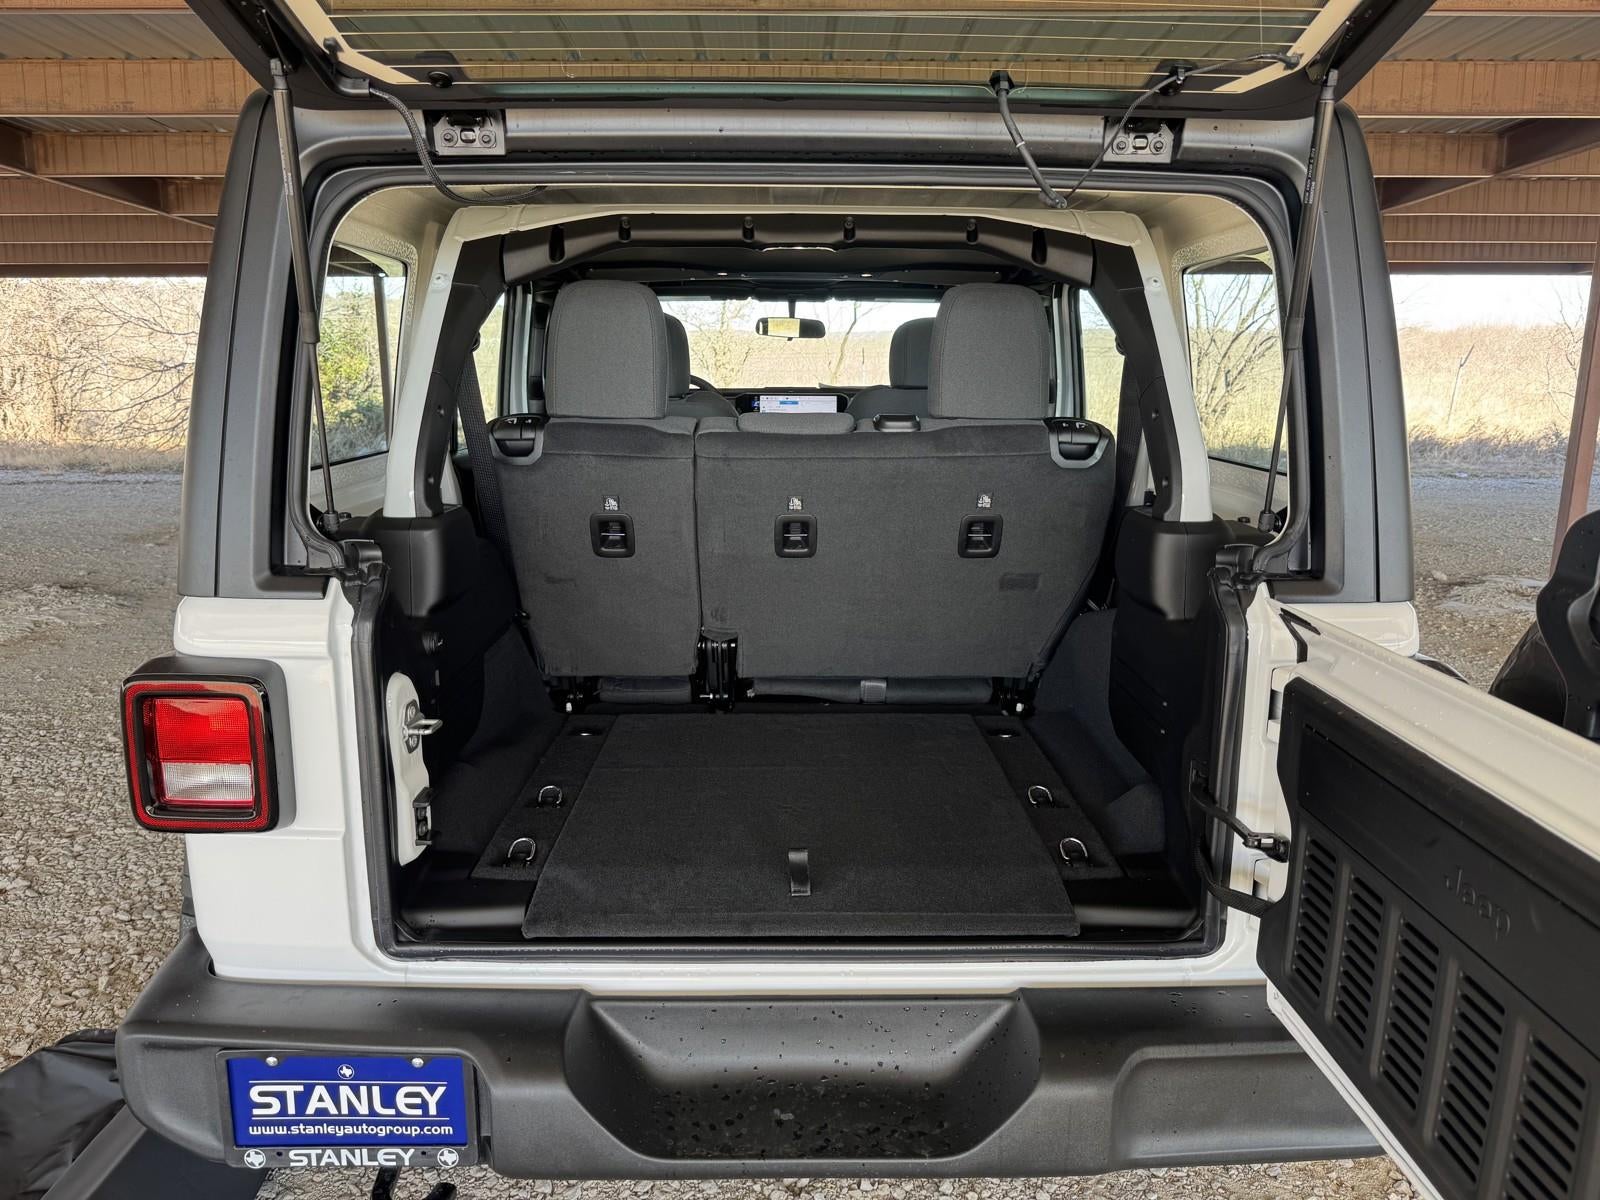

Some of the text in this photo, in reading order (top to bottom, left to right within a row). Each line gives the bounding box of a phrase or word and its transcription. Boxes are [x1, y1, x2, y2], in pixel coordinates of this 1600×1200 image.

[1444, 866, 1511, 942] Jeep
[249, 1085, 447, 1115] STANLEY
[248, 1122, 453, 1137] www.stanleyautogroup.com
[288, 1148, 415, 1167] STANLEY
